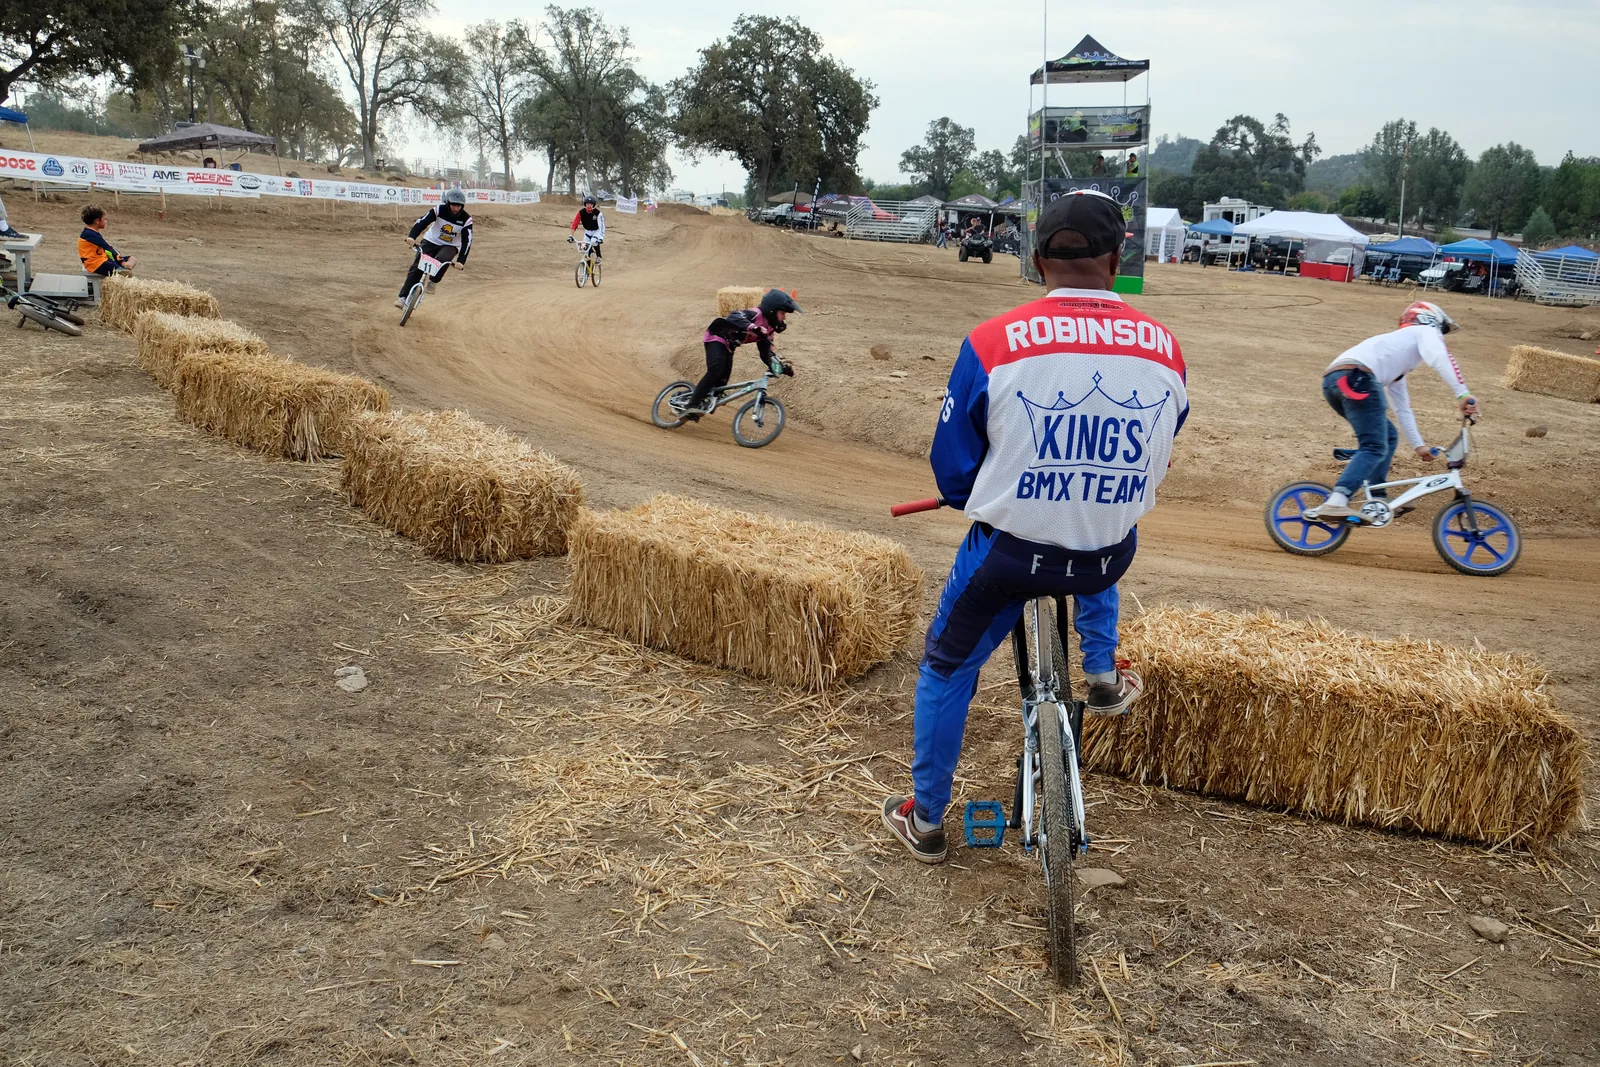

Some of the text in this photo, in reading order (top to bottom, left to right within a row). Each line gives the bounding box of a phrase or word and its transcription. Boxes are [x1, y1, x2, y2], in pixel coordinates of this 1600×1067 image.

[119, 164, 147, 177] BASSETT
[152, 170, 181, 180] AME
[187, 172, 216, 183] RACE
[423, 261, 433, 274] 11
[1004, 315, 1173, 361] ROBINSON
[1037, 413, 1144, 465] KING'S
[1016, 470, 1149, 504] BMX TEAM
